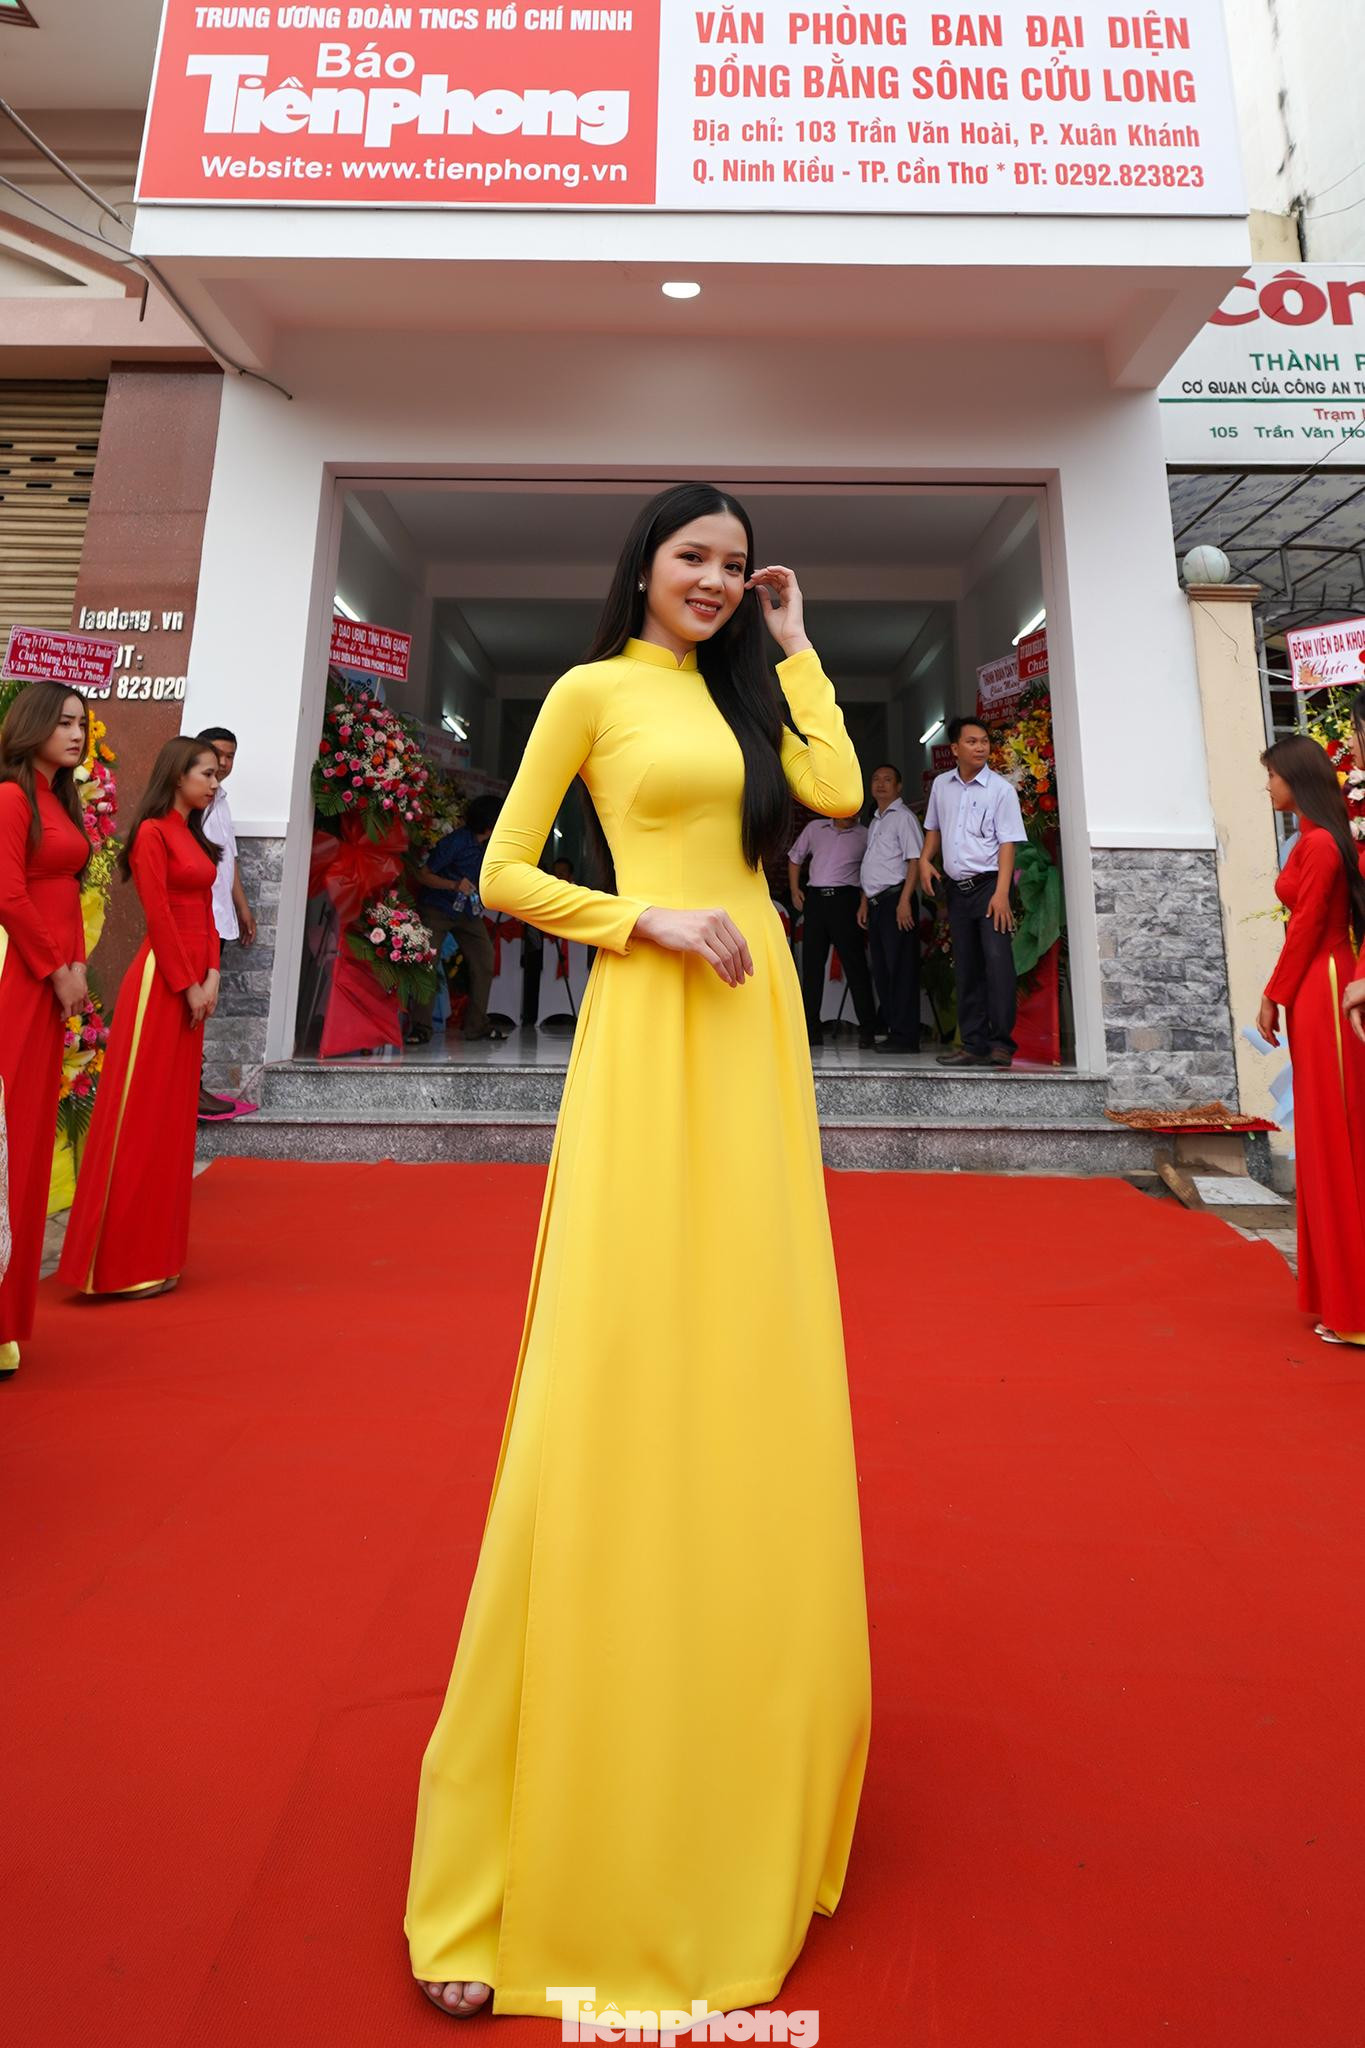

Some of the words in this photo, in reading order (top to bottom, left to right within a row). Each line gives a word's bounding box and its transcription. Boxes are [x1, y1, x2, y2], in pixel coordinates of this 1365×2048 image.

[195, 7, 270, 28] TRUNG
[278, 6, 341, 29] ƯƠNG
[348, 4, 412, 30] ĐOÀN
[419, 8, 478, 30] TNCS
[486, 3, 518, 30] HỒ
[525, 5, 563, 31] CHÍ
[571, 9, 632, 31] MINH
[696, 6, 764, 45] VĂN
[789, 6, 907, 46] PHÒNG
[932, 14, 1003, 47] BAN
[1026, 15, 1083, 55] ĐẠI
[1108, 10, 1190, 56] DIỆN
[316, 43, 416, 79] Báo
[694, 54, 790, 98] ĐỒNG
[804, 53, 899, 99] BẰNG
[912, 60, 1008, 101] SÔNG
[1021, 57, 1091, 102] CỬU
[1104, 69, 1195, 103] LONG
[693, 119, 730, 146] Địa
[741, 118, 783, 142] chỉ:
[796, 121, 836, 142] 103
[847, 117, 896, 143] Trần
[907, 121, 949, 145] Văn
[961, 122, 1018, 147] Hoài,
[1030, 123, 1048, 145] P.
[1060, 122, 1117, 146] Xuân
[1128, 124, 1200, 147] Khánh
[201, 156, 333, 179] Website:
[341, 158, 628, 188] www.tienphong.vn
[693, 160, 714, 183] Q.
[723, 159, 775, 182] Ninh
[783, 156, 834, 183] Kiều
[858, 161, 888, 184] TP.
[896, 157, 941, 184] Cần
[948, 161, 989, 185] Thơ
[1013, 163, 1047, 186] ĐT:
[1055, 163, 1205, 188] 0292.823823
[1249, 349, 1340, 372] THÀNH
[1182, 379, 1203, 394] CƠ
[1208, 381, 1247, 394] QUAN
[1251, 377, 1280, 394] CỦA
[1284, 378, 1326, 394] CÔNG
[1332, 381, 1351, 394] AN
[1313, 408, 1356, 423] Trạm
[1210, 426, 1239, 439] 105
[1254, 424, 1294, 439] Trần
[1301, 426, 1334, 439] Văn
[1333, 634, 1346, 653] ĐA
[117, 676, 186, 700] 823020
